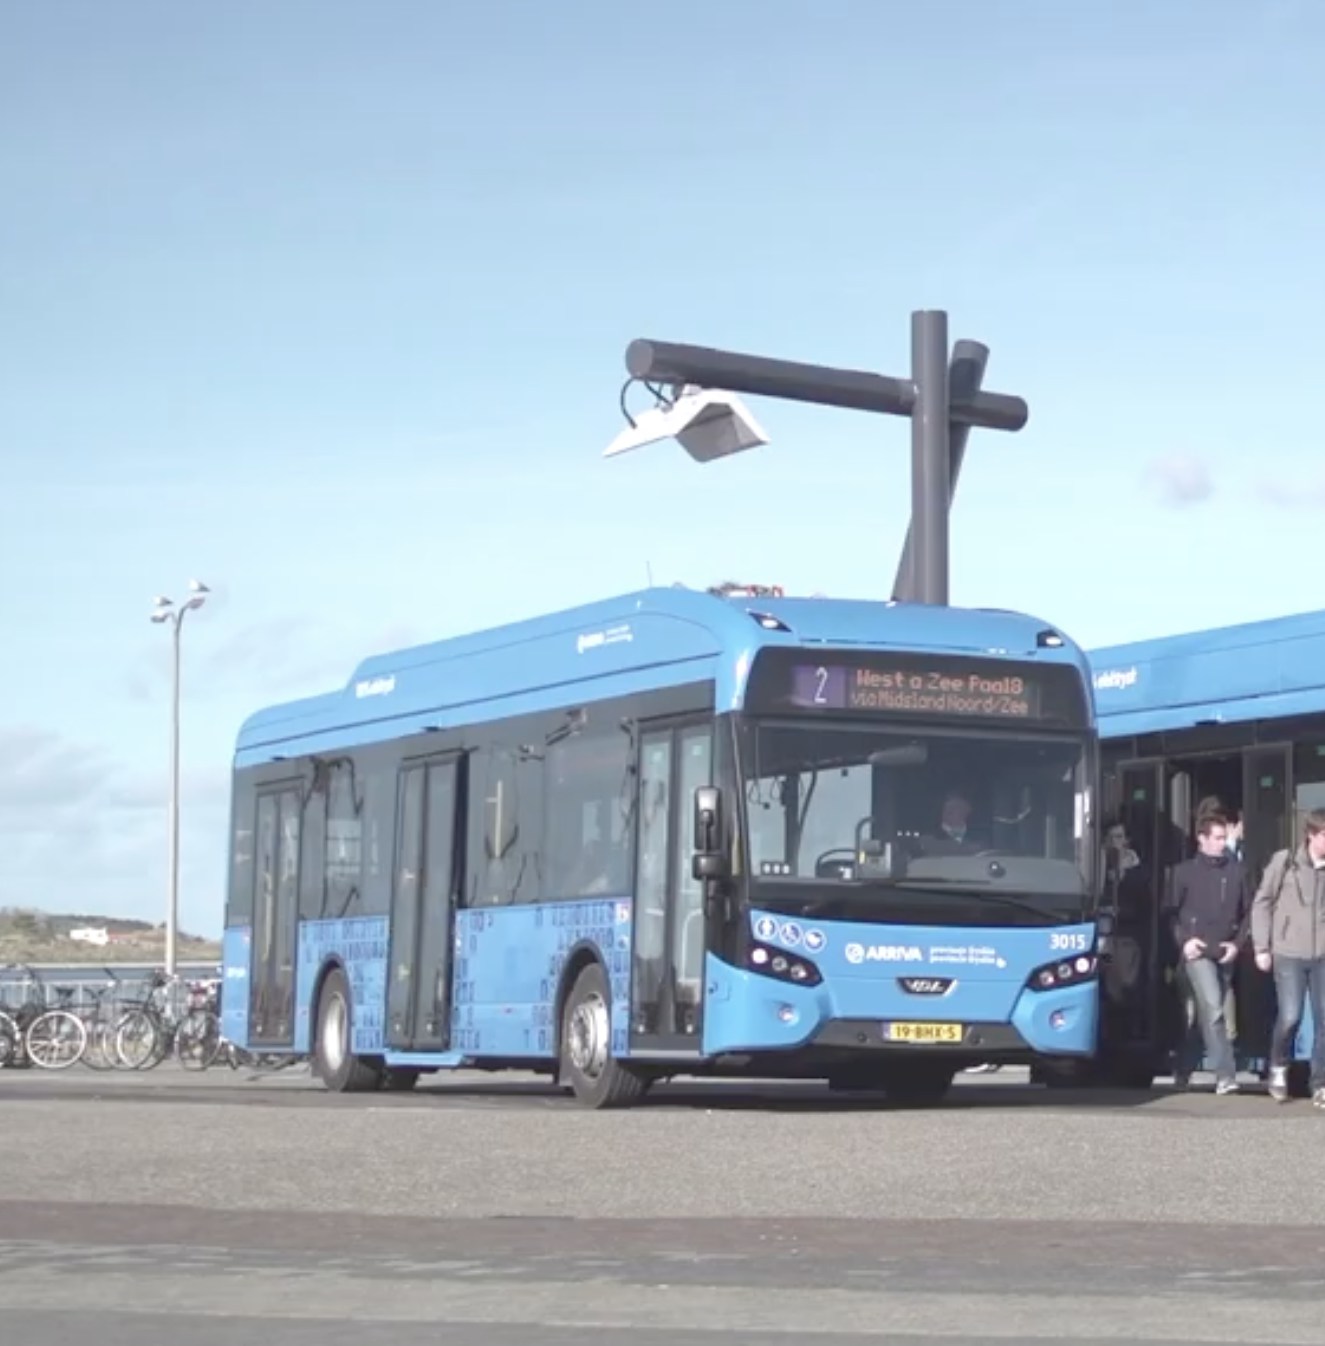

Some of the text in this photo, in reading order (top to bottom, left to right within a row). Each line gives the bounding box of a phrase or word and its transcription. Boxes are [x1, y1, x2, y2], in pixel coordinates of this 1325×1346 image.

[814, 665, 829, 705] 2
[856, 669, 904, 688] West
[927, 672, 963, 692] Zee
[1049, 933, 1086, 951] 3015
[866, 945, 923, 962] ARRIVA
